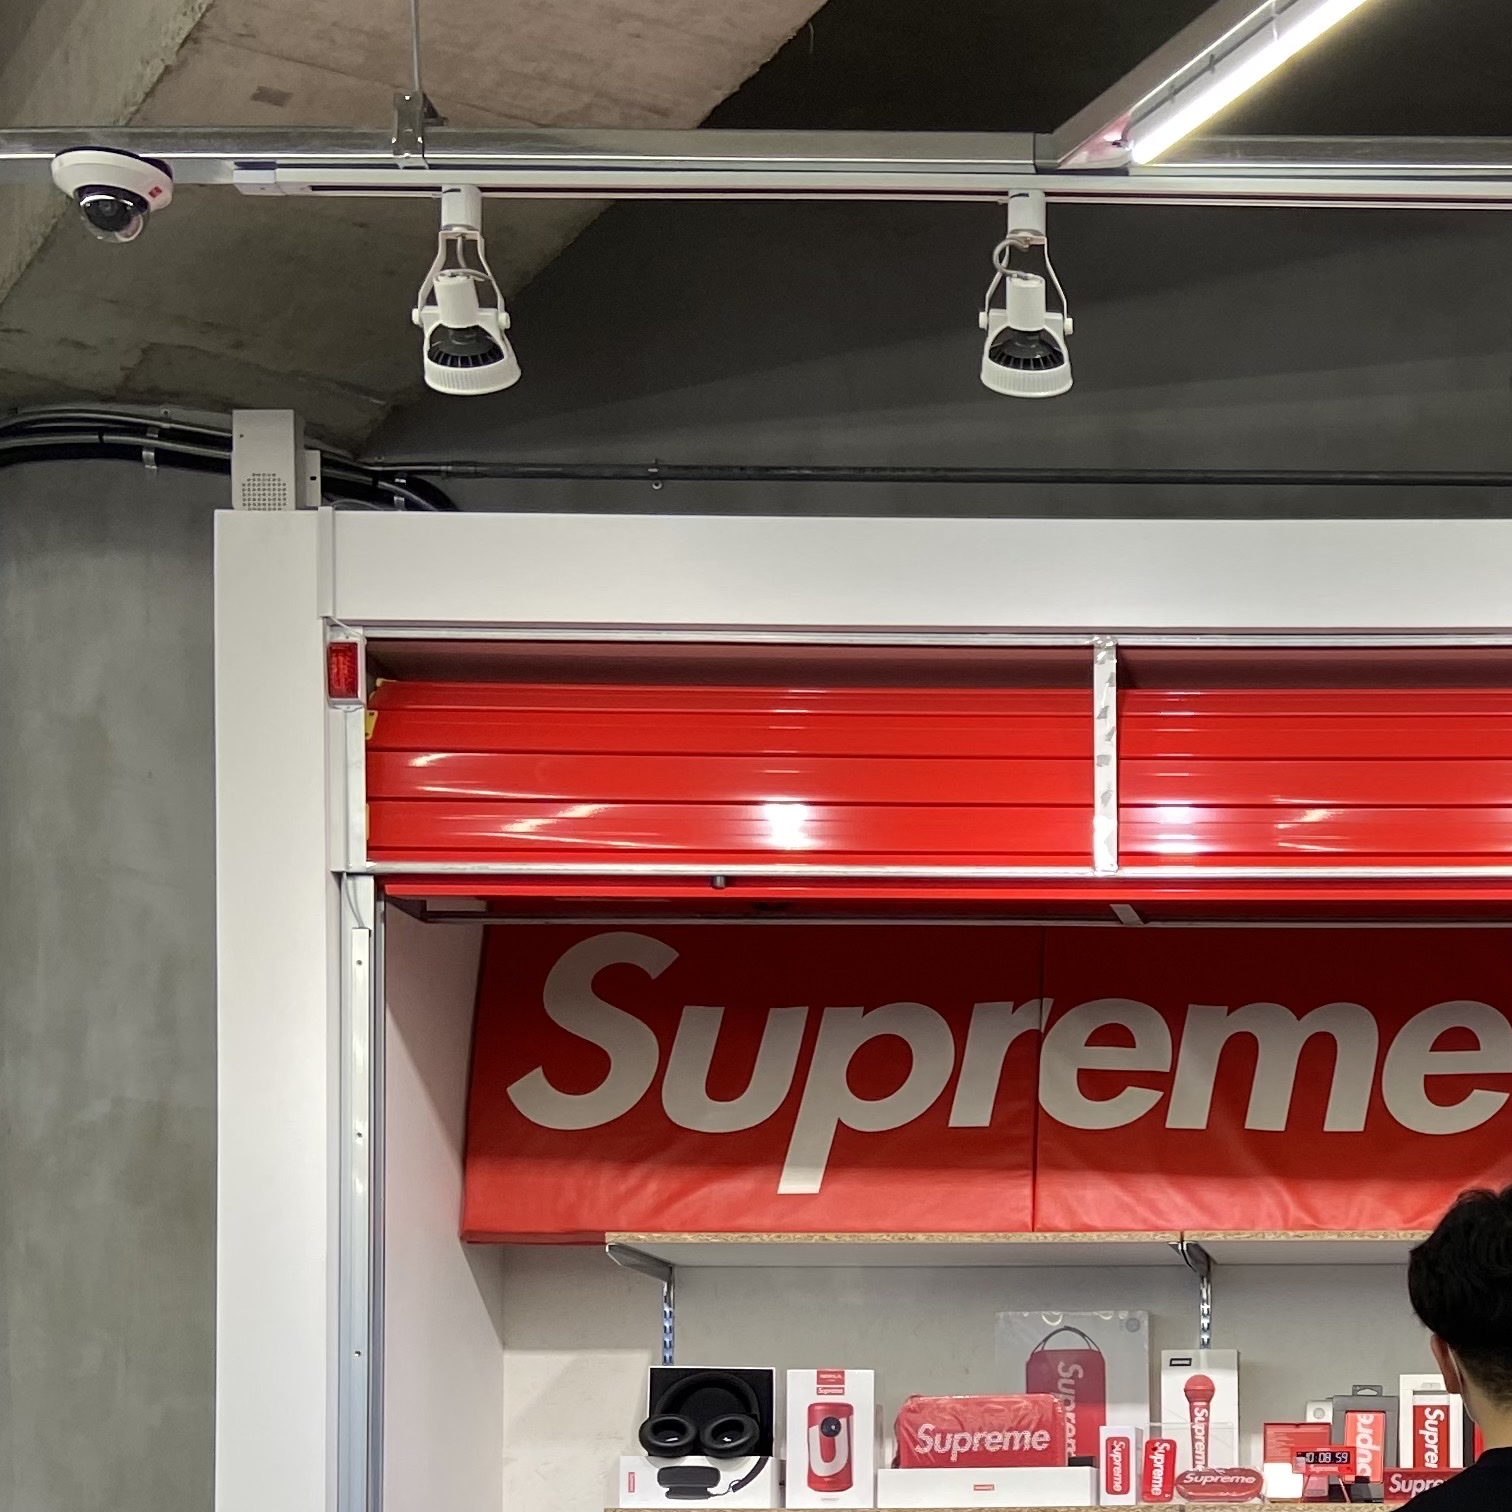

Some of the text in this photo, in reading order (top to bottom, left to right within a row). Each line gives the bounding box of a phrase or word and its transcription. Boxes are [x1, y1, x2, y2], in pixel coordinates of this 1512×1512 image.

[914, 1423, 1051, 1463] Supreme
[1110, 1440, 1126, 1492] Supreme
[1150, 1441, 1171, 1496] Supreme
[1182, 1473, 1256, 1486] Supreme
